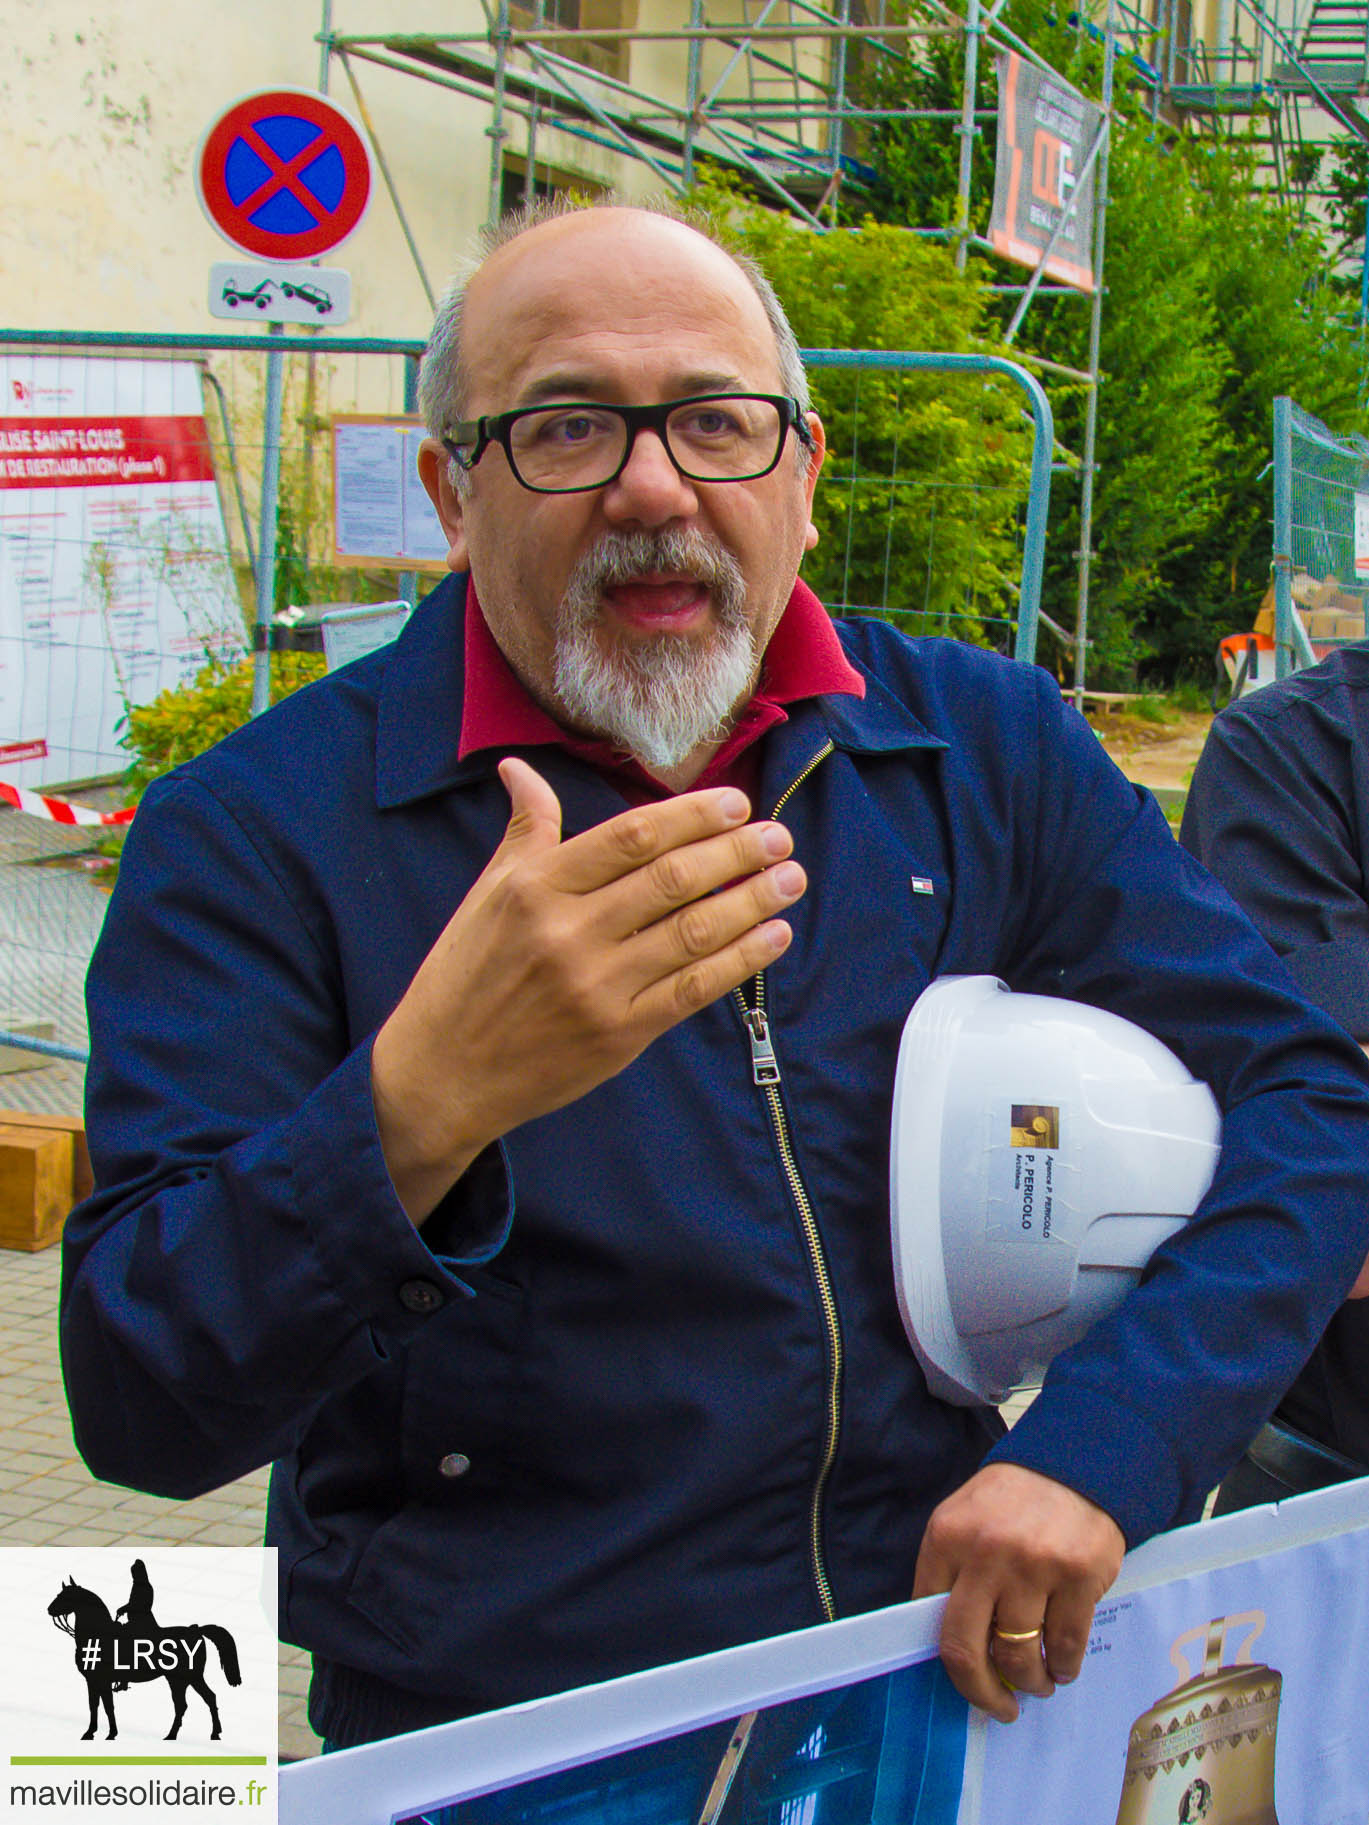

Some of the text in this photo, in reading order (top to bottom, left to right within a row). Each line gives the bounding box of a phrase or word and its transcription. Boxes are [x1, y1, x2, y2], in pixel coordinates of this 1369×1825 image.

[1022, 1154, 1035, 1230] P. PERICOLO
[1043, 1196, 1053, 1239] PERICOLO
